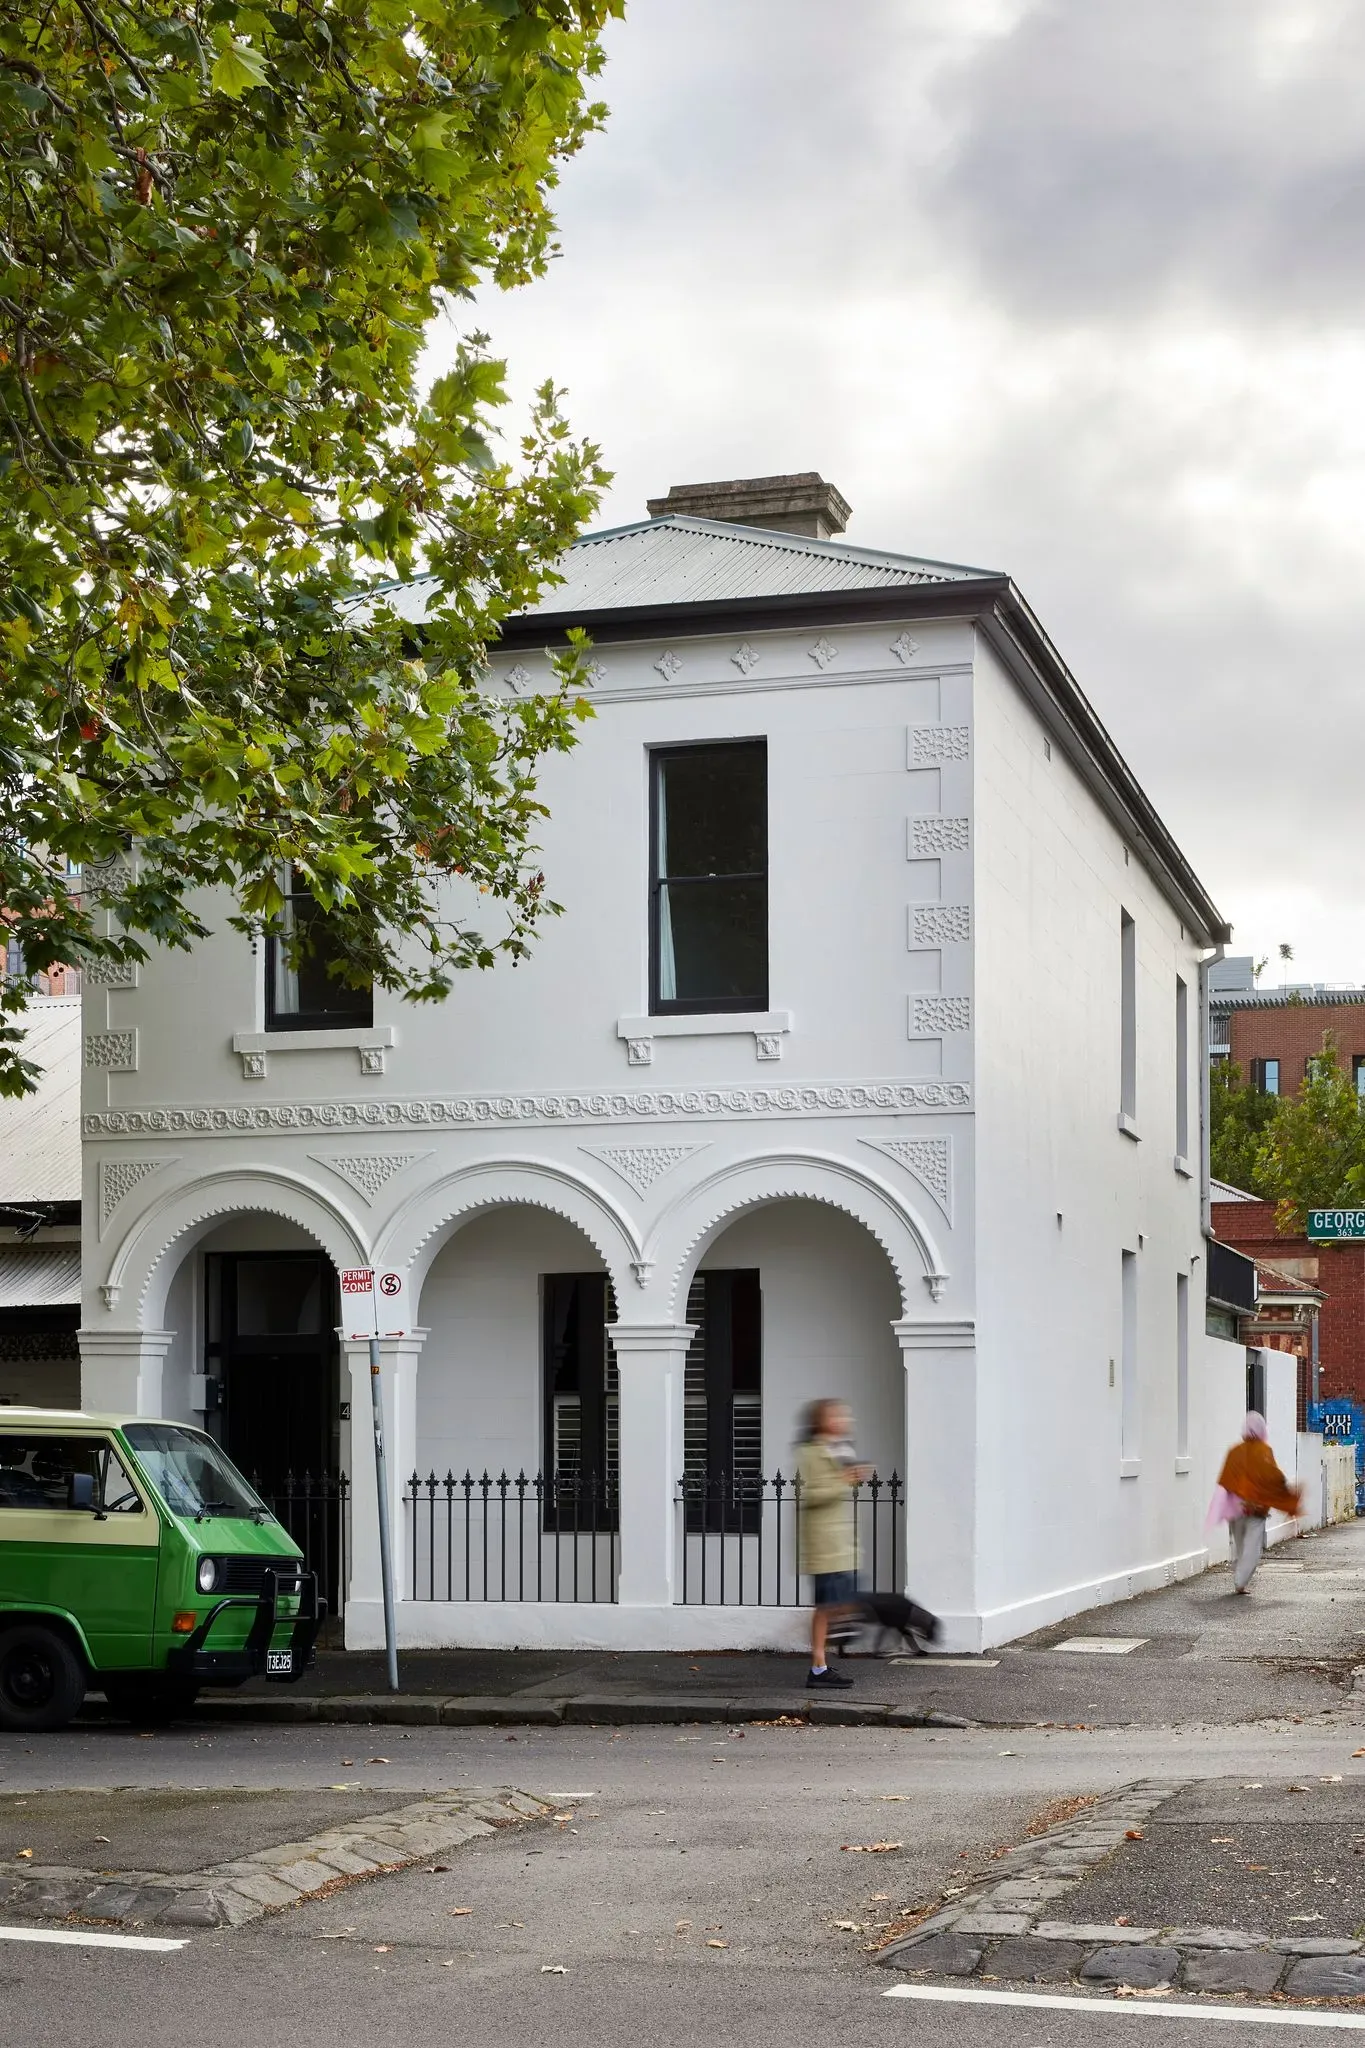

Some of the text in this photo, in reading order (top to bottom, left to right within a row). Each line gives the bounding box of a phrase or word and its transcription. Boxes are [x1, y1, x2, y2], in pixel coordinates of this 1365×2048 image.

[1314, 1212, 1365, 1228] GEORG
[1337, 1228, 1352, 1237] 363
[342, 1270, 371, 1281] PERMIT
[343, 1282, 372, 1292] ZONE
[341, 1404, 351, 1419] 4
